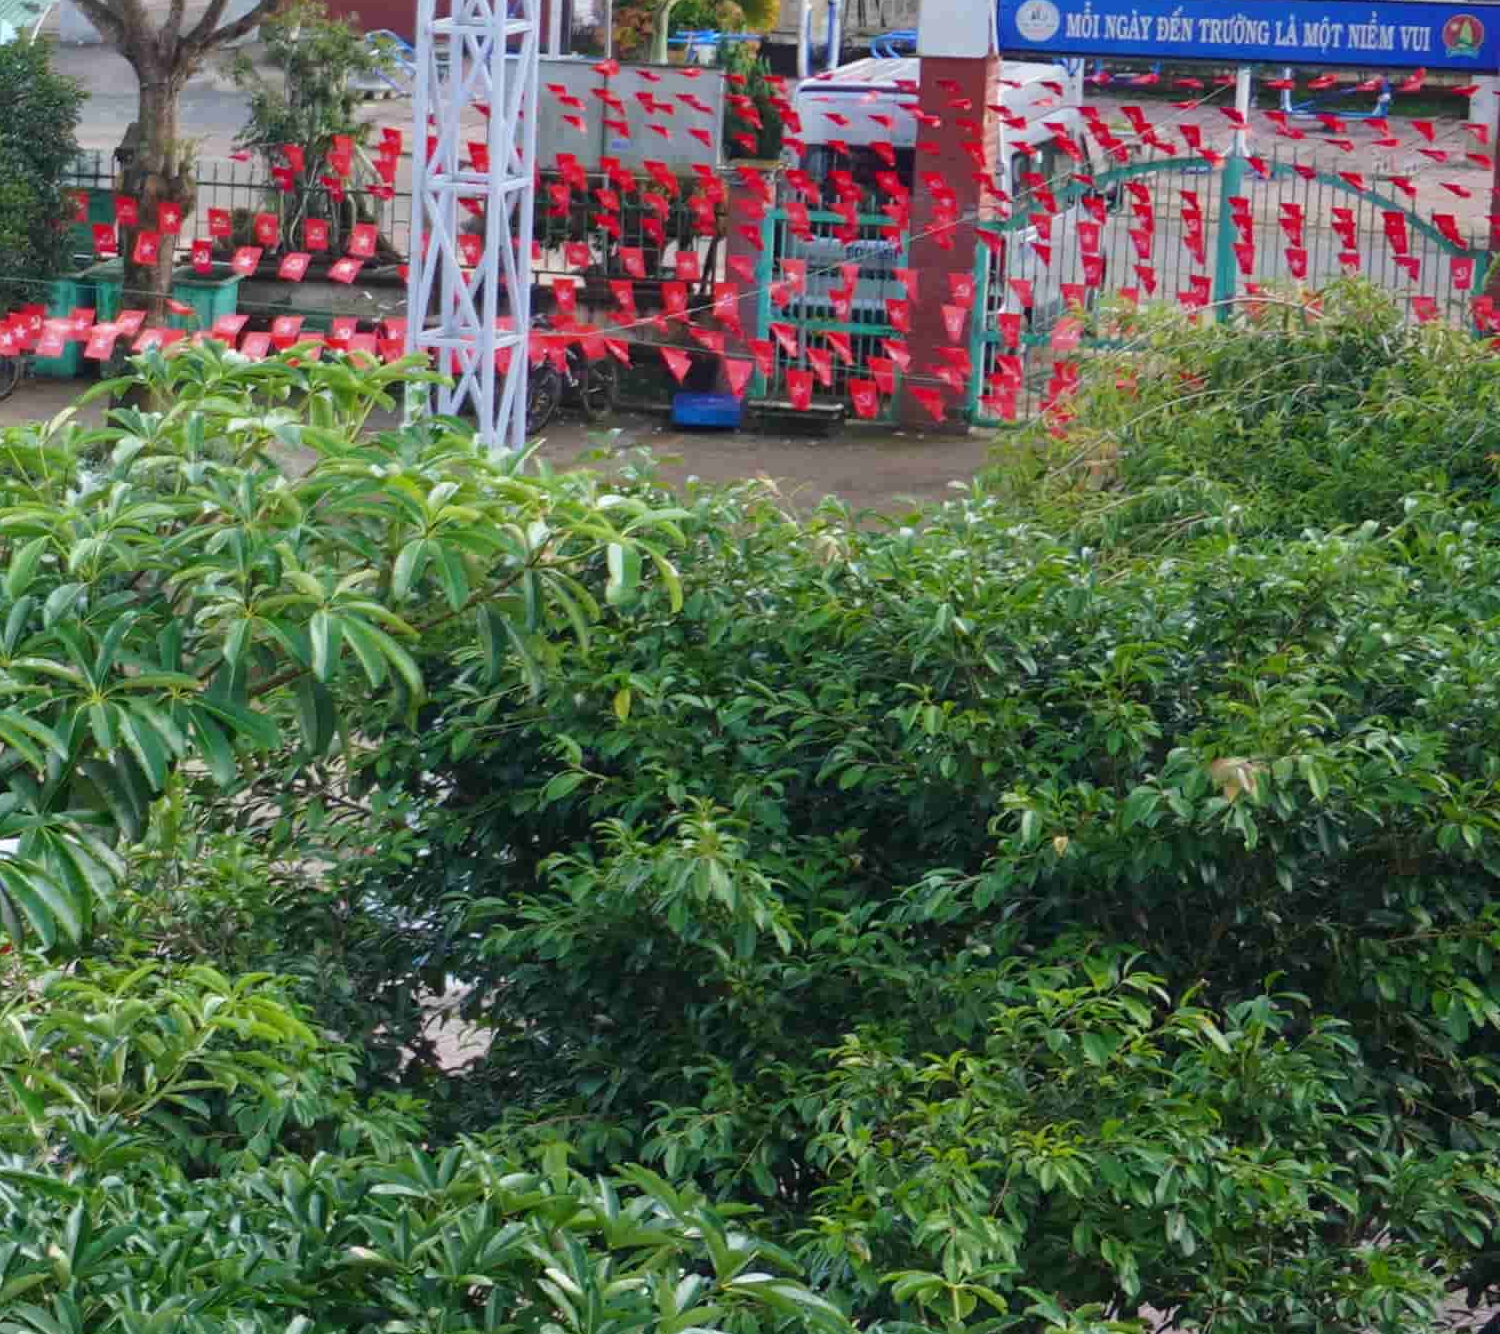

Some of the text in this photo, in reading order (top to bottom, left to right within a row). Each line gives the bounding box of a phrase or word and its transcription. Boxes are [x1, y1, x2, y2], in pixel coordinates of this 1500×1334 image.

[1103, 8, 1153, 40] NGÀY
[1156, 4, 1194, 42] ĐẾN
[1198, 12, 1271, 45] TRƯỜNG
[1274, 14, 1298, 46] LÀ
[1302, 16, 1344, 54] MỘT
[1399, 26, 1432, 52] VUI
